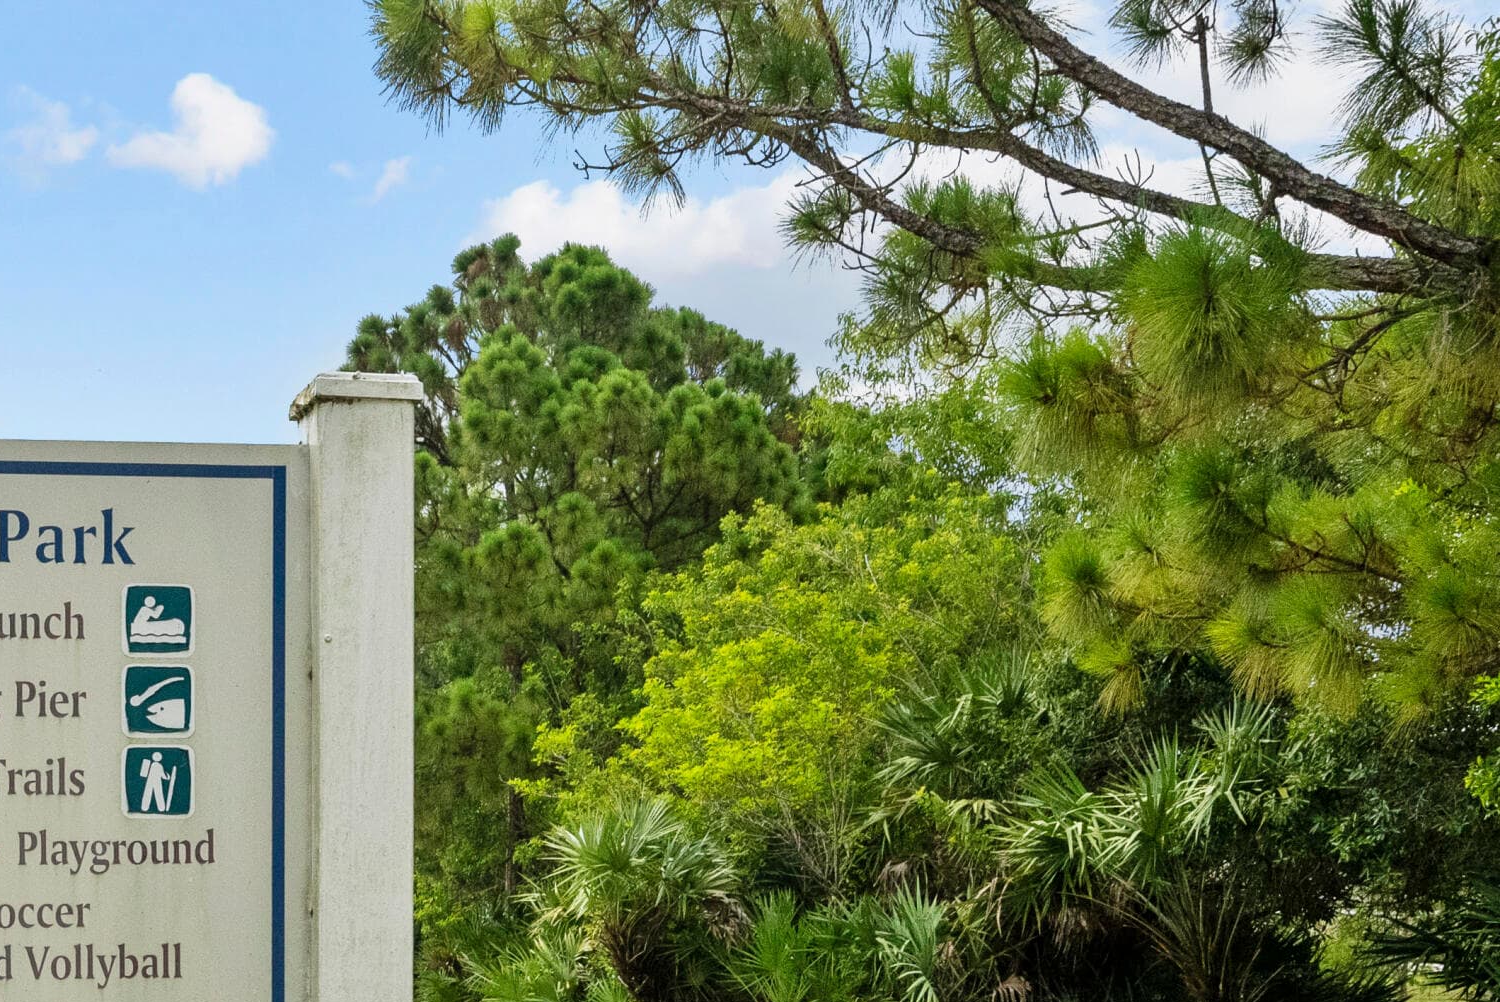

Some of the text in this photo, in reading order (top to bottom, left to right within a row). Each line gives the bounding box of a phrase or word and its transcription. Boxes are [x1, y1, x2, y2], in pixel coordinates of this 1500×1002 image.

[14, 680, 87, 719] Pier
[17, 827, 216, 876] Playground
[24, 942, 183, 990] Vollyball
